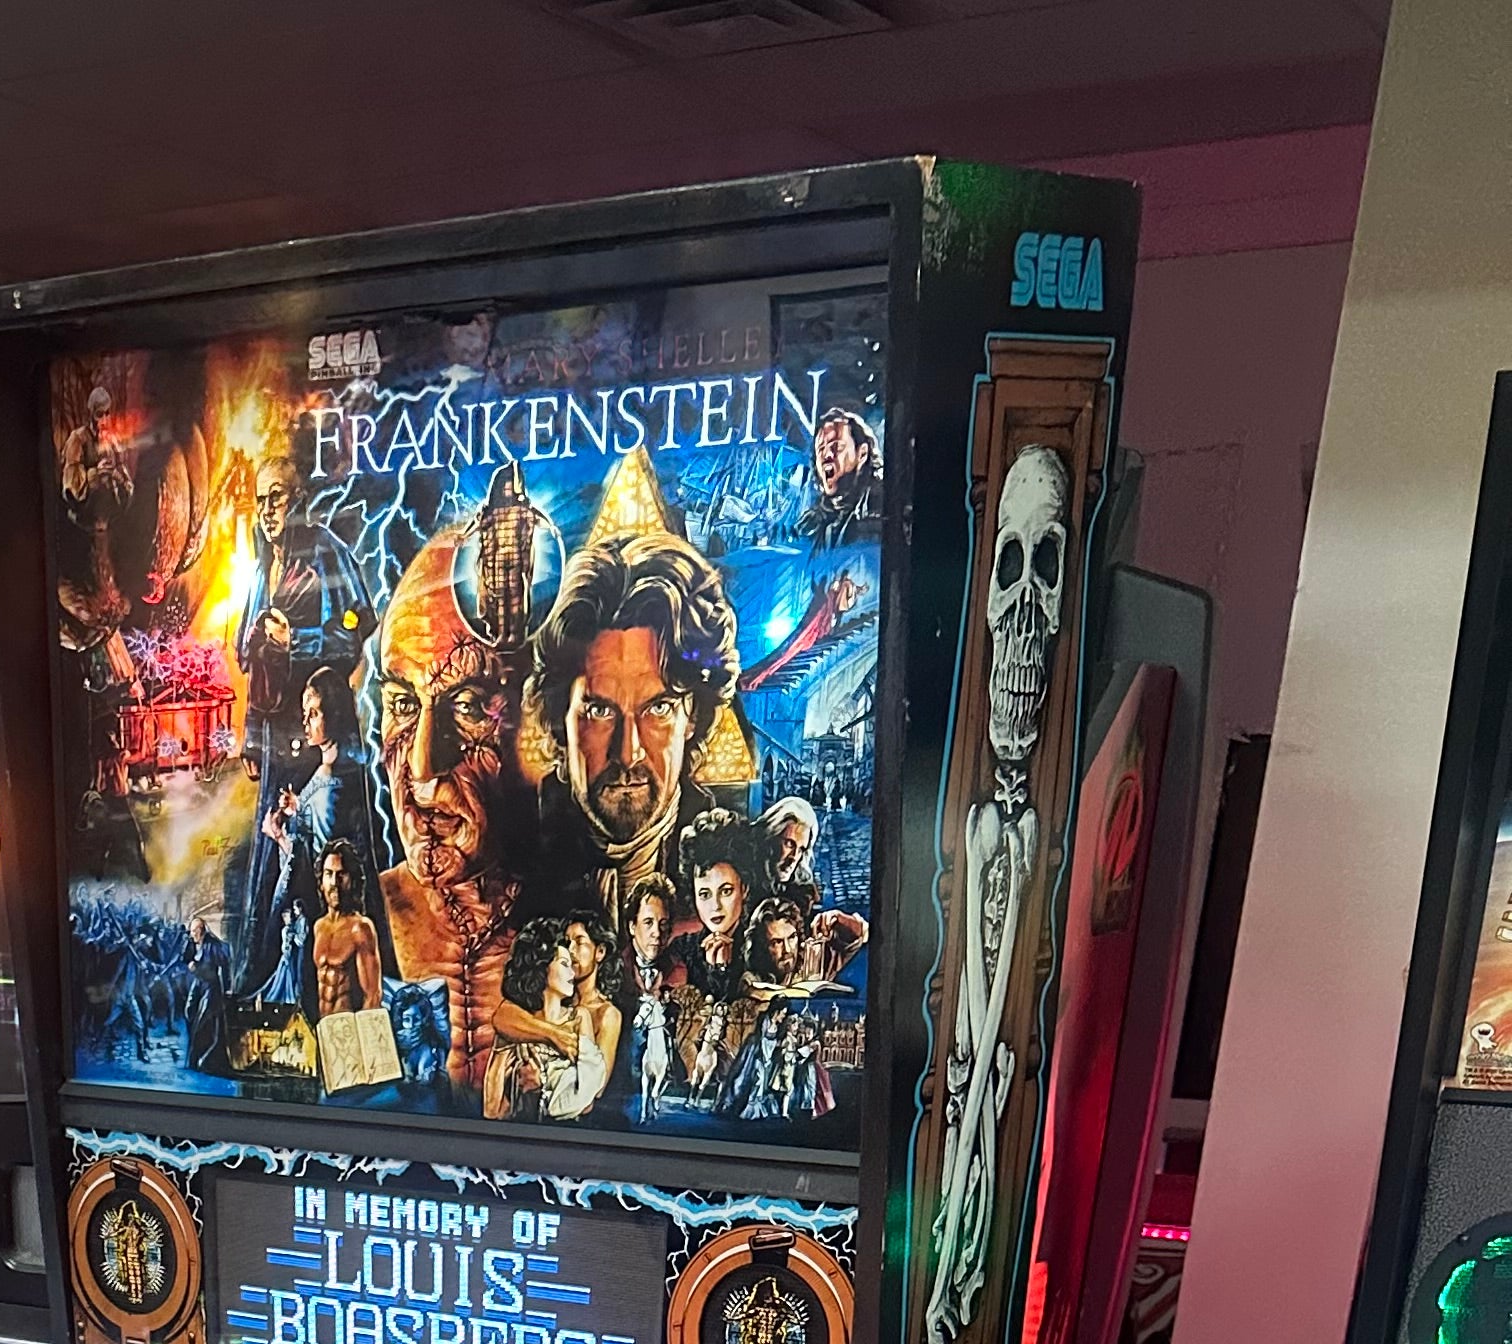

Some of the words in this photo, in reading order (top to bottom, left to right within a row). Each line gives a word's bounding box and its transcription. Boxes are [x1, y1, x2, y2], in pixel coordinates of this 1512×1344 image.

[1010, 231, 1103, 312] SEGA
[308, 330, 380, 370] SEGA
[310, 368, 827, 479] FRANKENSTEIN
[294, 1185, 327, 1222] IN
[344, 1190, 490, 1240] MEMORY
[513, 1209, 562, 1247] OF
[322, 1228, 526, 1318] LOUIS
